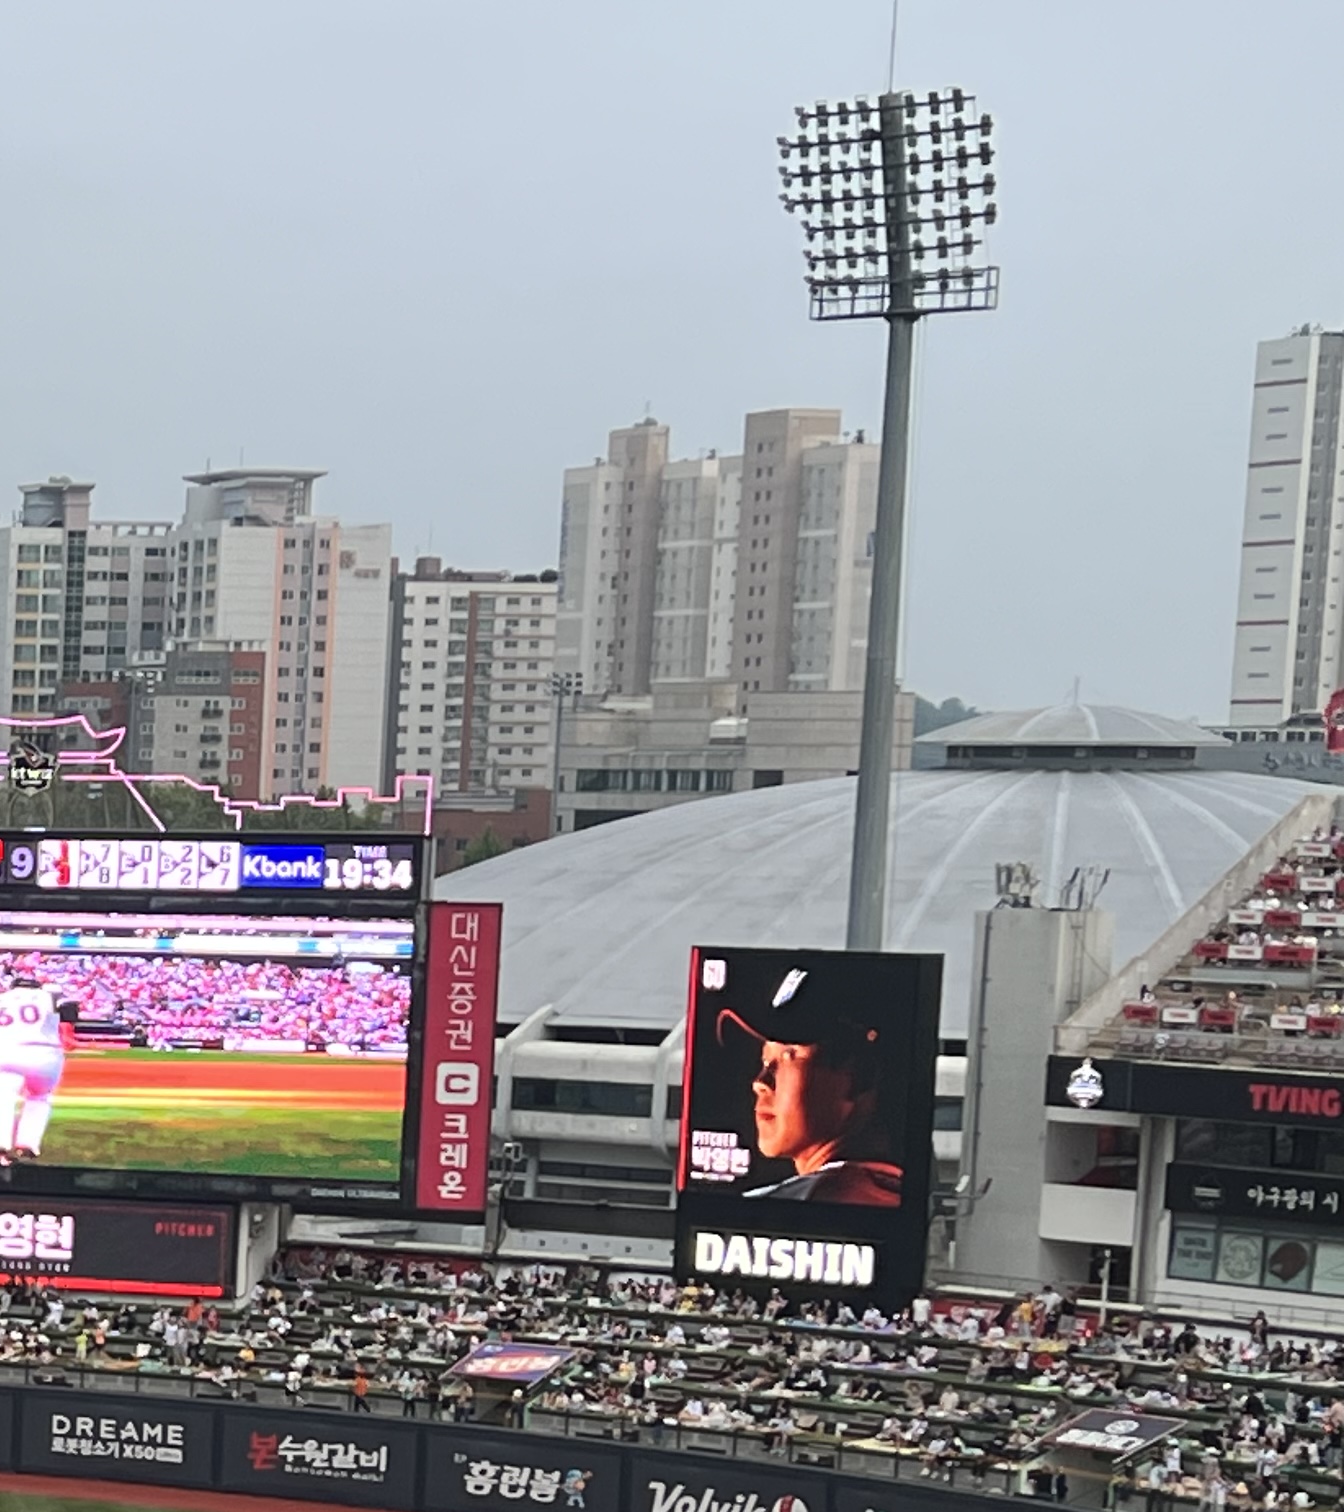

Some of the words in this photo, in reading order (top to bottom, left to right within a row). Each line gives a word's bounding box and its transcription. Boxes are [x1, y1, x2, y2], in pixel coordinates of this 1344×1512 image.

[11, 846, 34, 878] 9
[242, 854, 323, 879] Kbank
[322, 857, 413, 890] 19:34
[444, 911, 480, 1051] 대신증권
[1248, 1083, 1342, 1117] TVING
[437, 1112, 469, 1200] 크레온
[154, 1220, 216, 1238] PITCHER
[694, 1231, 876, 1287] DAISHIN
[51, 1413, 185, 1446] DREAME
[122, 1443, 156, 1461] X50
[247, 1430, 389, 1473] 본수원갈비
